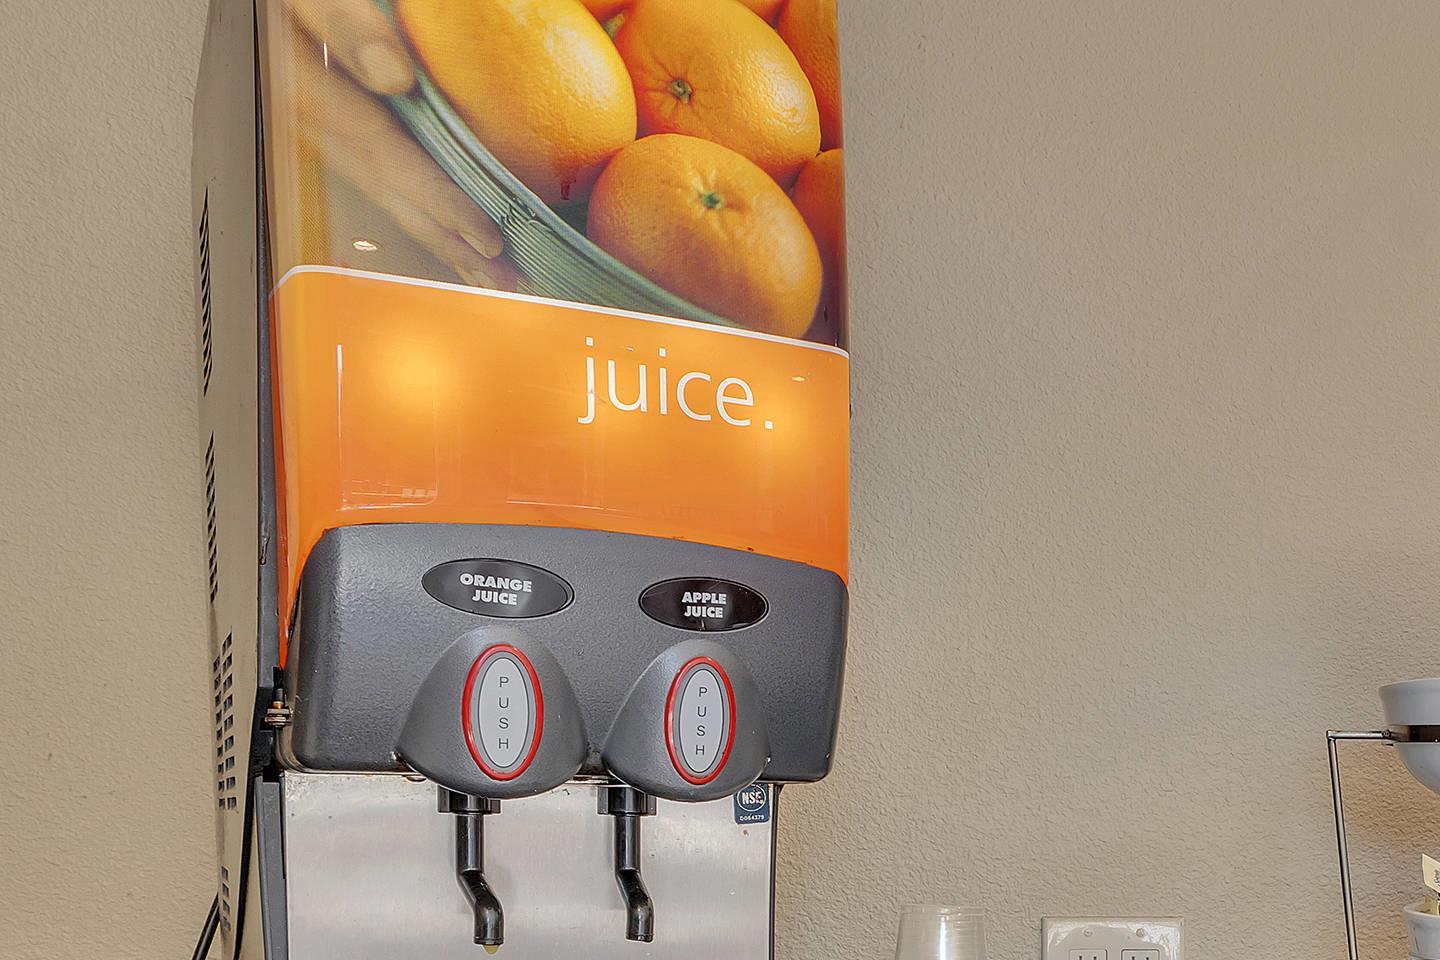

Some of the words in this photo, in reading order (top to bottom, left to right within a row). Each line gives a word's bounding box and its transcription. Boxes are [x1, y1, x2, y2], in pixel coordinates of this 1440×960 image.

[577, 336, 774, 430] juice.
[459, 573, 532, 593] ORANGE
[472, 589, 518, 605] JUICE
[682, 591, 727, 605] APPLE
[684, 605, 724, 619] JUICE
[498, 676, 510, 750] PUSH
[695, 687, 708, 756] PUSH
